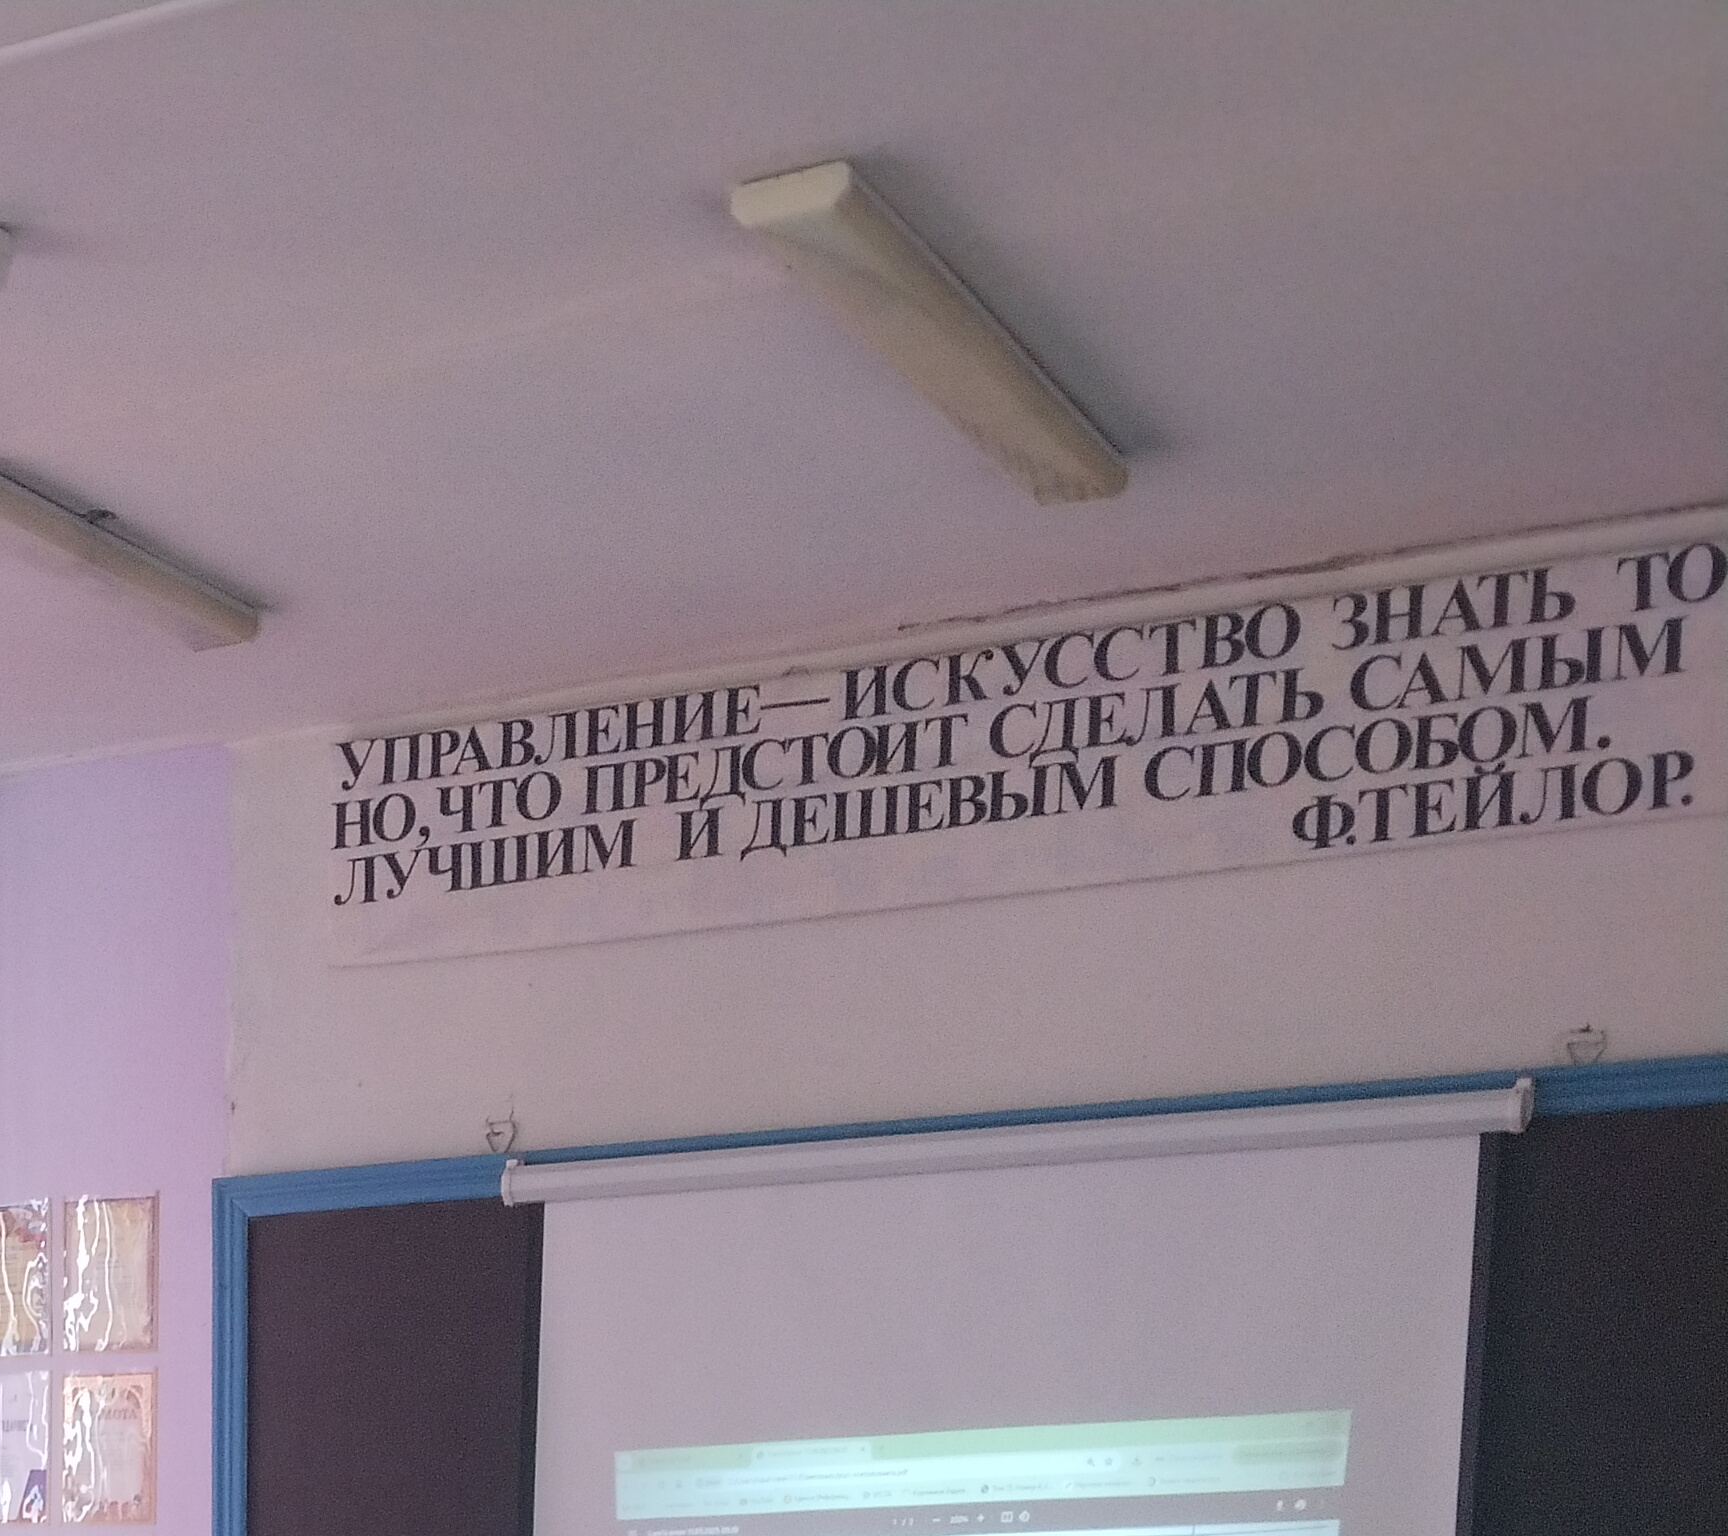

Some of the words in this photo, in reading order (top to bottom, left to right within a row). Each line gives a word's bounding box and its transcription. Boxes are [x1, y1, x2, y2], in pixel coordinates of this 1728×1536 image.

[1332, 568, 1576, 651] ЗНАТЬ
[1616, 542, 1728, 612] ТО
[333, 818, 639, 906] ЛУЧШИМ
[676, 805, 725, 860] И
[740, 754, 1121, 861] ДЕШЕВЫМ
[1144, 696, 1612, 801] СПОСОБОМ.
[581, 713, 968, 815] ПРЕДСТОИТ
[989, 667, 1325, 769] СДЕЛАТЬ
[1350, 615, 1690, 712] САМЫМ
